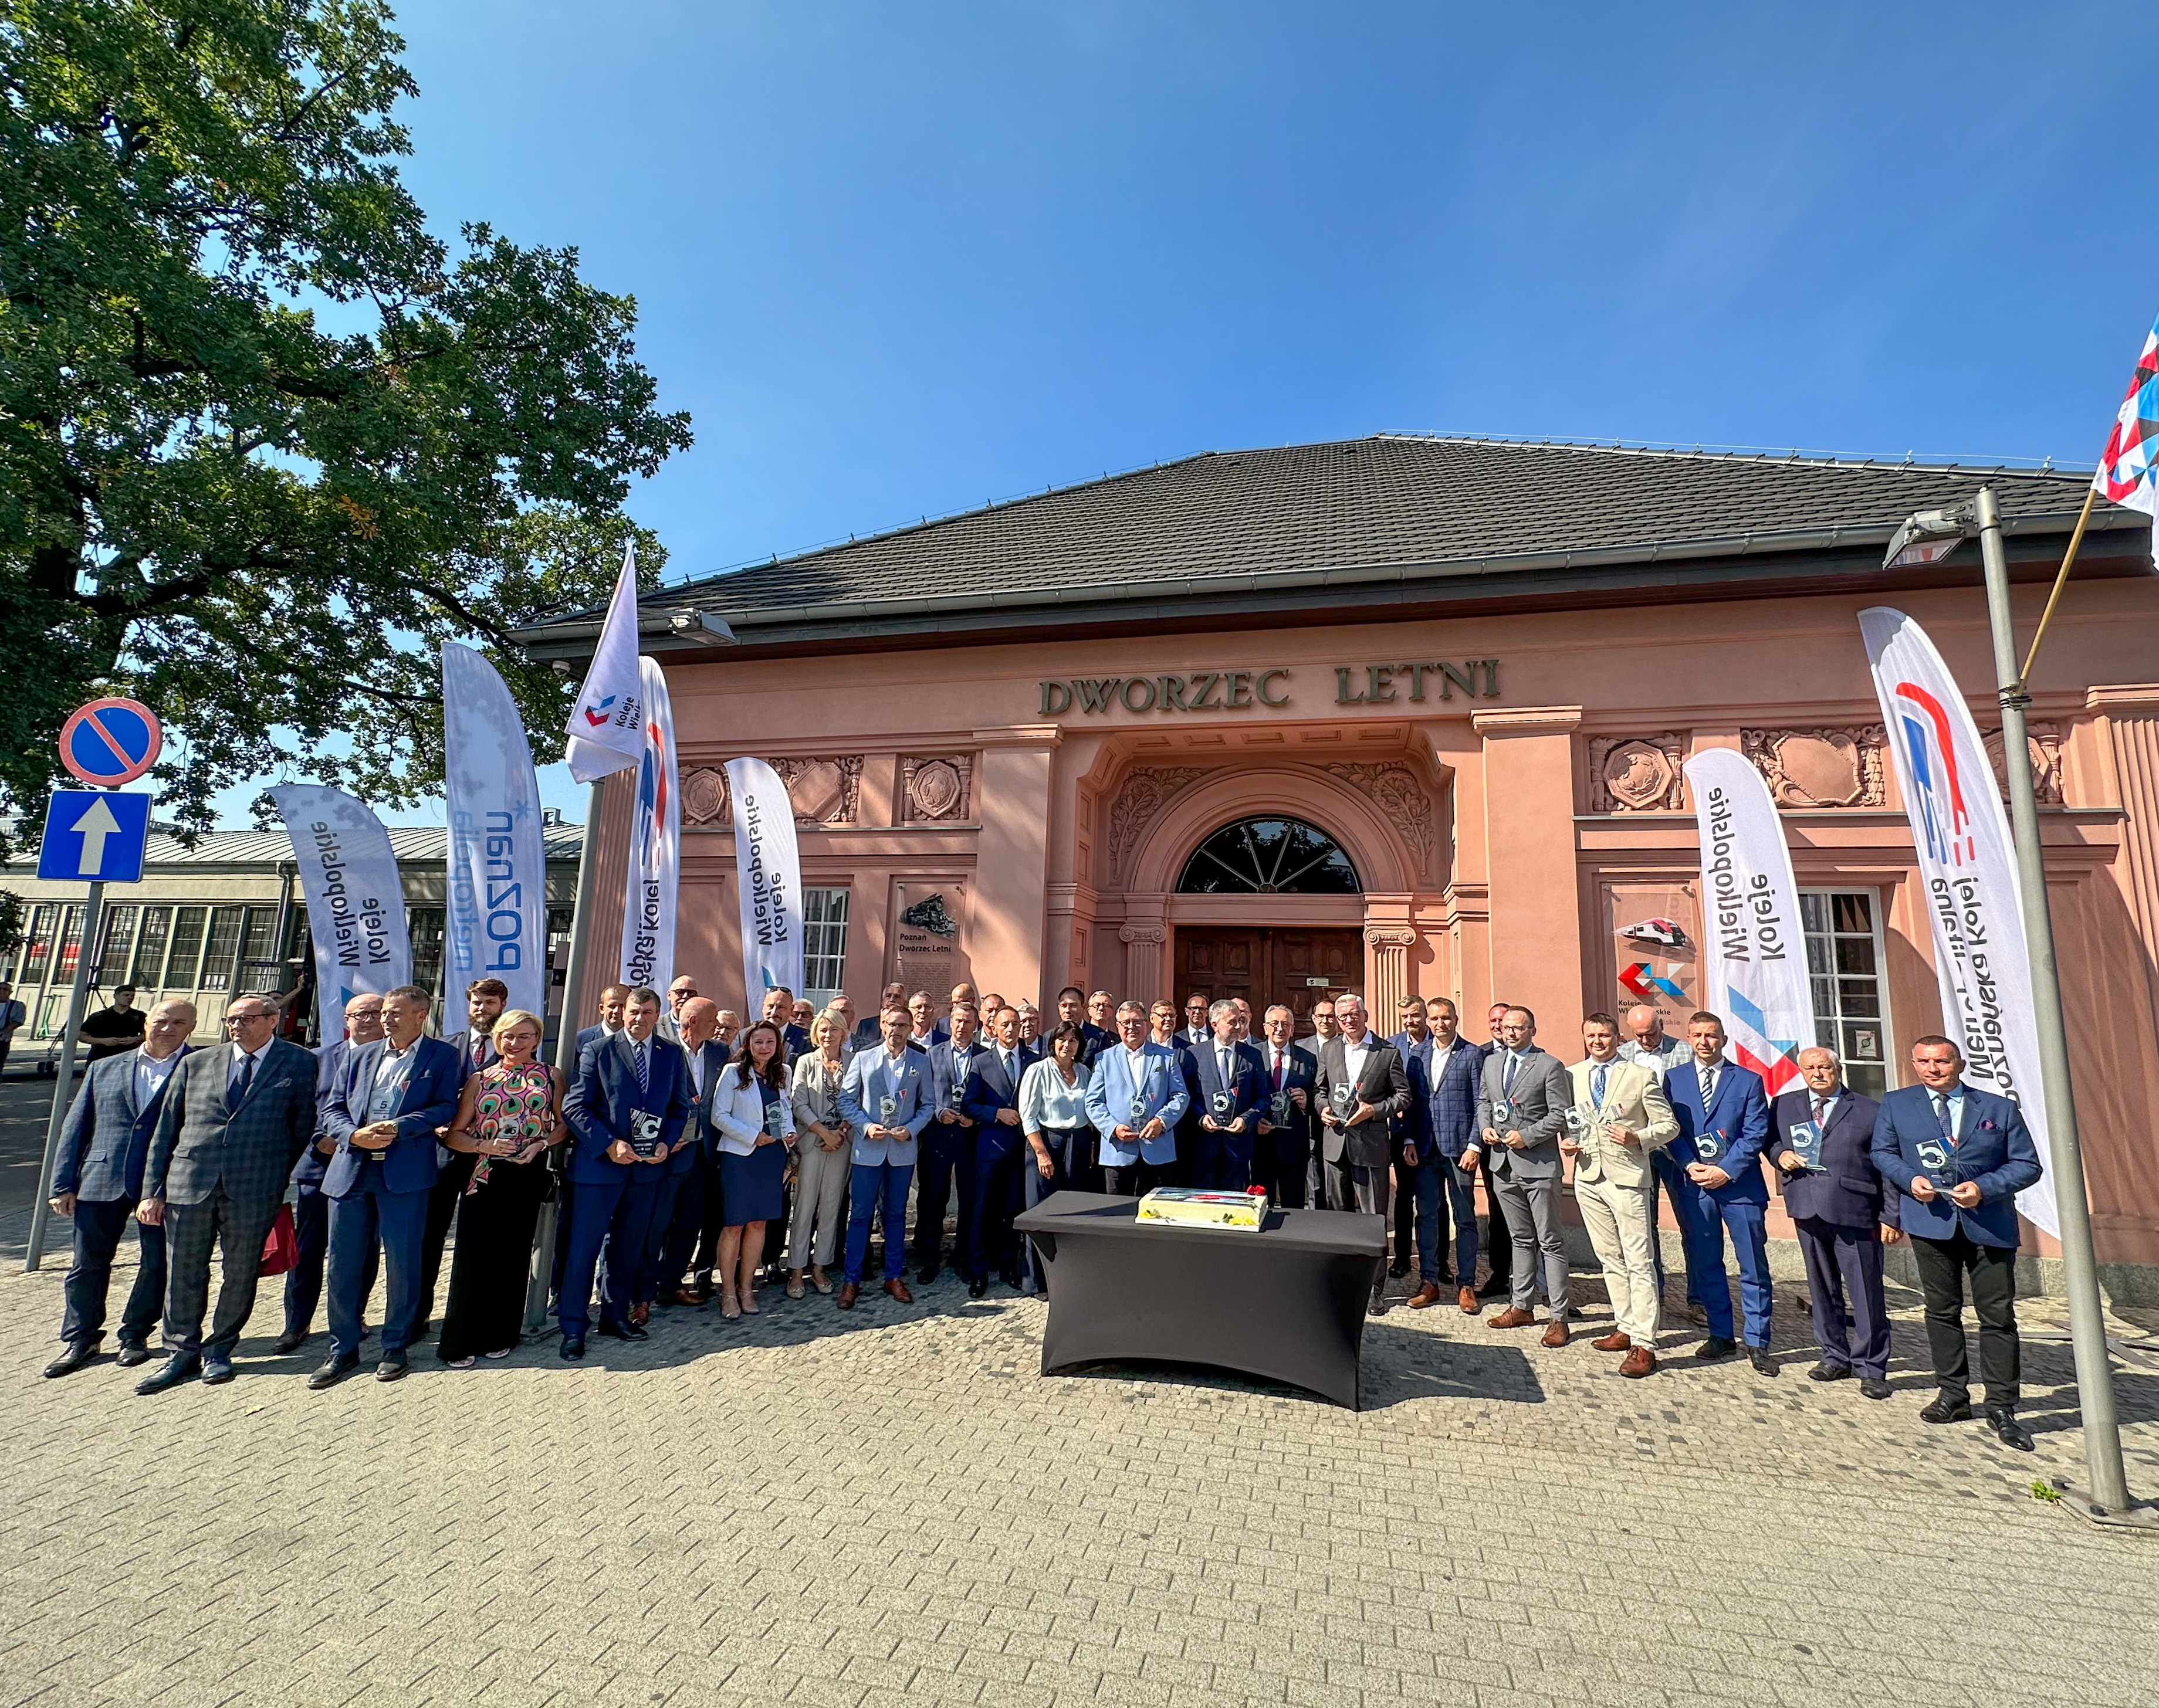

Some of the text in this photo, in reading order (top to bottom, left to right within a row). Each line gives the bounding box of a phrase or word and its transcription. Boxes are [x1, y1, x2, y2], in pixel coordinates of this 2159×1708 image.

[1038, 659, 1501, 715] DWORZEC LETNI
[614, 696, 634, 727] Koleje
[900, 933, 927, 941] Poznań
[899, 944, 951, 953] Dworzec Letni
